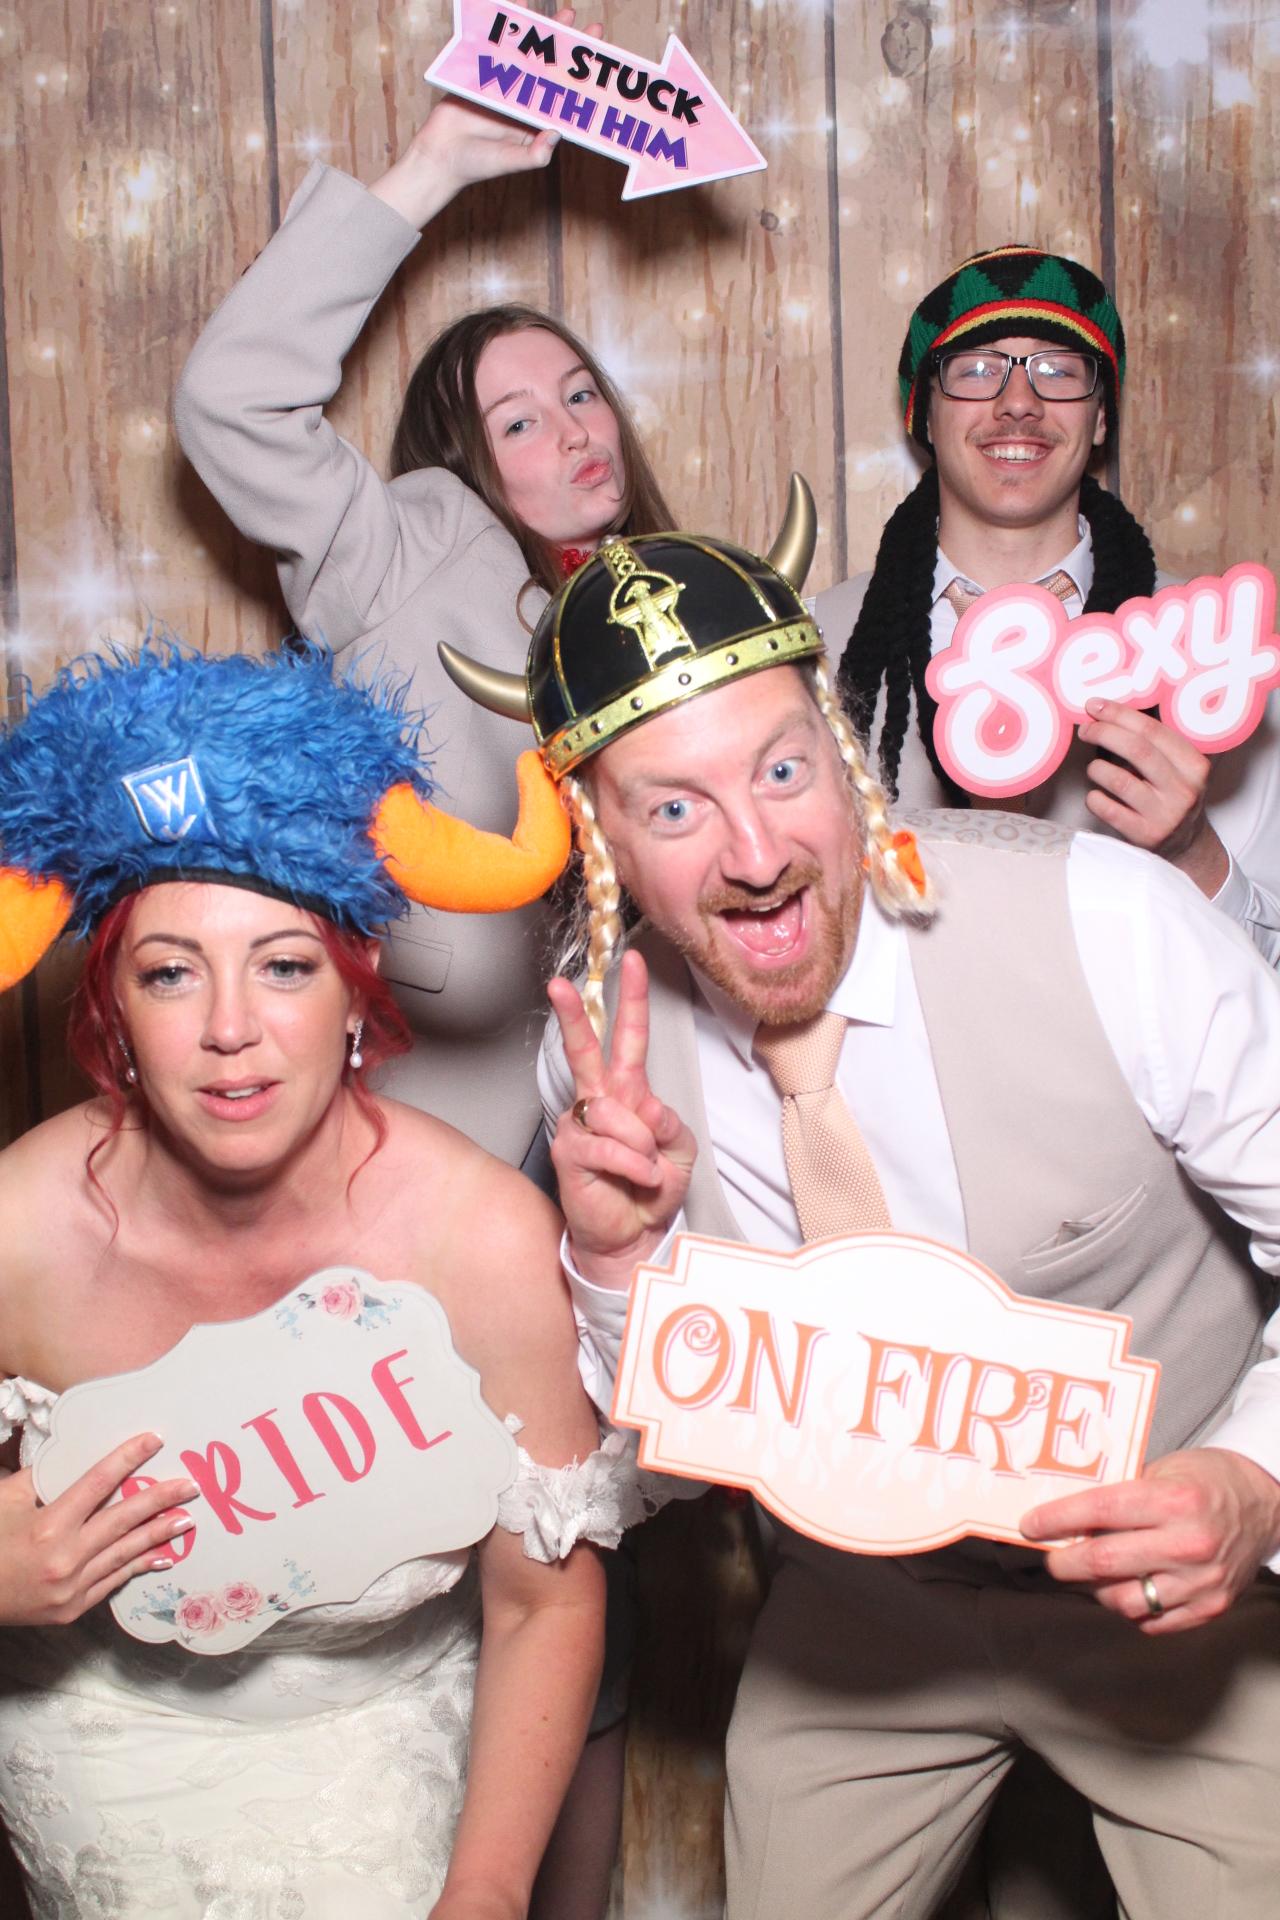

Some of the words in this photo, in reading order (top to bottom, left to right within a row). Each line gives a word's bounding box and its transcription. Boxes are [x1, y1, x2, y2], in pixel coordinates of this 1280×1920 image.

[477, 55, 597, 133] WITH
[599, 106, 687, 170] HIM
[487, 12, 556, 65] I'M
[567, 46, 703, 126] STUCK
[943, 581, 1276, 781] Sexy
[652, 1303, 828, 1427] ON
[846, 1331, 1111, 1478] FIRE
